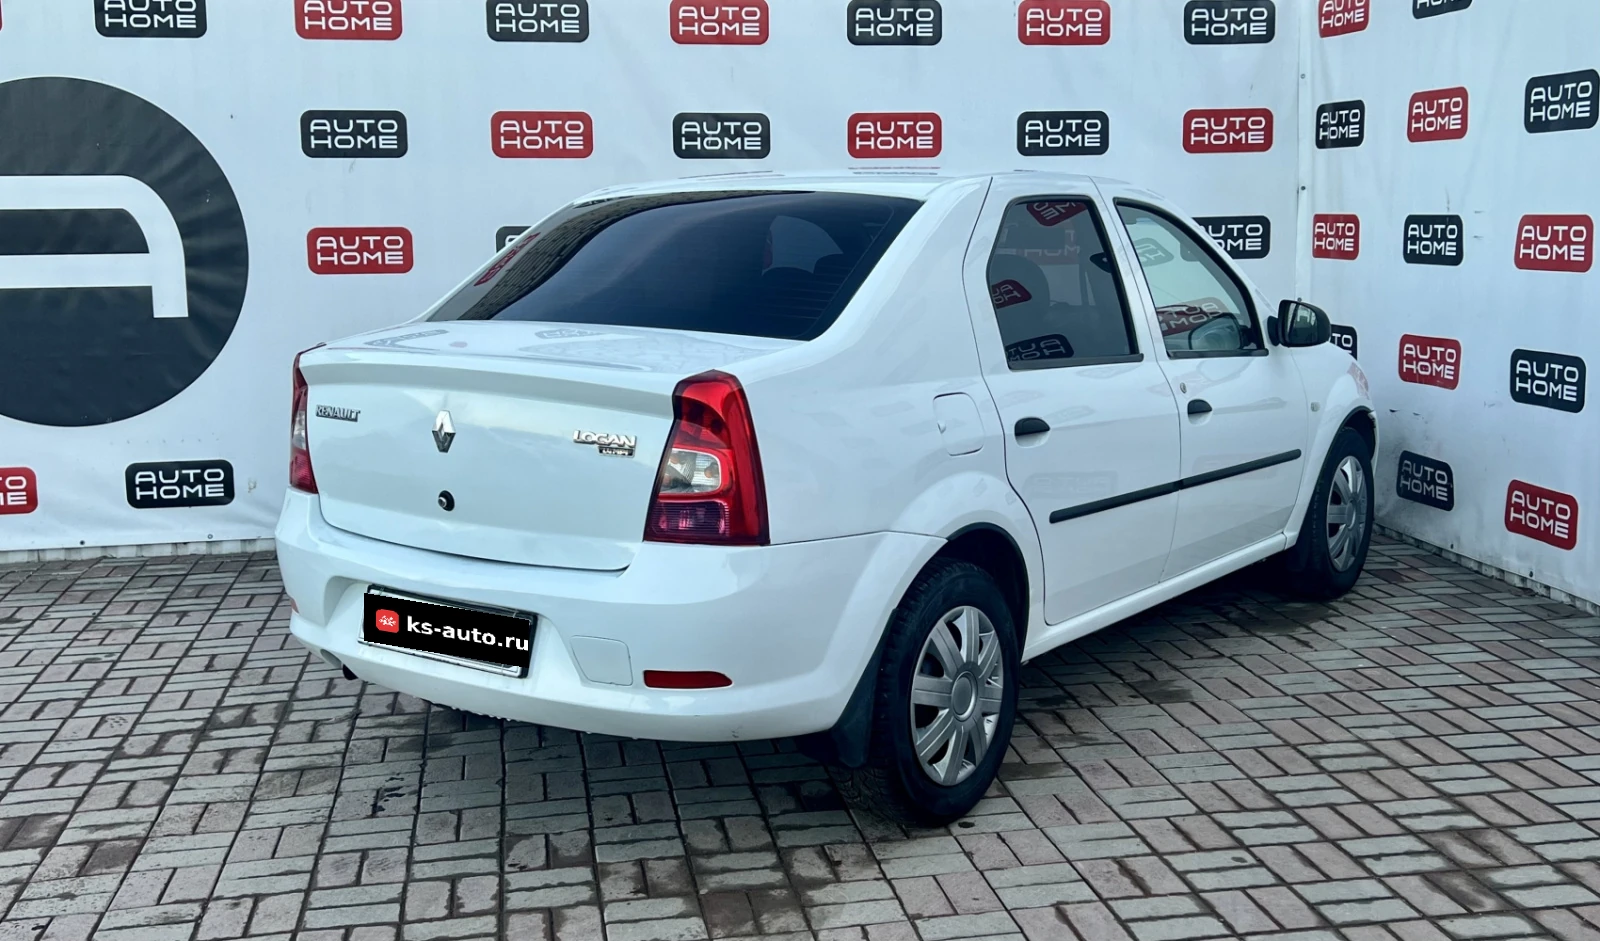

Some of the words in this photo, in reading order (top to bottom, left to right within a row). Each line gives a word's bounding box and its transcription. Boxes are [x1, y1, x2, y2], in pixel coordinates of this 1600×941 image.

[104, 0, 196, 11] AUTO
[304, 0, 392, 14] AUTO
[496, 3, 580, 17] AUTO
[679, 6, 760, 20] AUTO
[856, 8, 934, 21] AUTO
[1027, 8, 1102, 21] AUTO
[1192, 8, 1267, 21] AUTO
[1321, 8, 1365, 29] HOME
[105, 14, 197, 28] HOME
[305, 16, 393, 30] HOME
[496, 19, 580, 33] HOME
[679, 22, 760, 36] HOME
[856, 23, 934, 37] HOME
[1027, 23, 1102, 36] HOME
[1192, 23, 1267, 36] HOME
[1530, 81, 1593, 103] AUTO
[1412, 97, 1462, 116] AUTO
[1529, 101, 1592, 122] HOME
[1191, 117, 1265, 130] AUTO
[1319, 109, 1360, 125] AUTO
[1411, 114, 1462, 133] HOME
[310, 120, 398, 133] AUTO
[501, 120, 584, 134] AUTO
[682, 121, 762, 134] AUTO
[856, 121, 934, 134] AUTO
[1025, 119, 1101, 132] AUTO
[1319, 124, 1360, 140] HOME
[310, 135, 398, 149] HOME
[501, 136, 584, 149] HOME
[682, 136, 762, 150] HOME
[856, 136, 934, 149] HOME
[1025, 134, 1101, 147] HOME
[1191, 131, 1265, 145] HOME
[1200, 224, 1263, 237] UTO
[1314, 223, 1355, 235] AUTO
[1407, 224, 1458, 238] AUTO
[1521, 226, 1586, 241] AUTO
[317, 236, 403, 249] AUTO
[1314, 237, 1355, 251] HOME
[1407, 240, 1457, 255] HOME
[317, 251, 403, 265] HOME
[1520, 243, 1586, 261] HOME
[1403, 343, 1457, 363] AUTO
[1403, 359, 1455, 379] HOME
[1515, 359, 1579, 382] AUTO
[1515, 377, 1578, 401] HOME
[316, 405, 360, 422] RENAULT
[573, 430, 637, 448] LOGAN
[135, 469, 225, 484] AUTO
[1402, 459, 1448, 485] AUTO
[135, 484, 225, 500] HOME
[1400, 474, 1448, 501] HOME
[1511, 490, 1571, 520] AUTO
[1510, 507, 1569, 538] HOME
